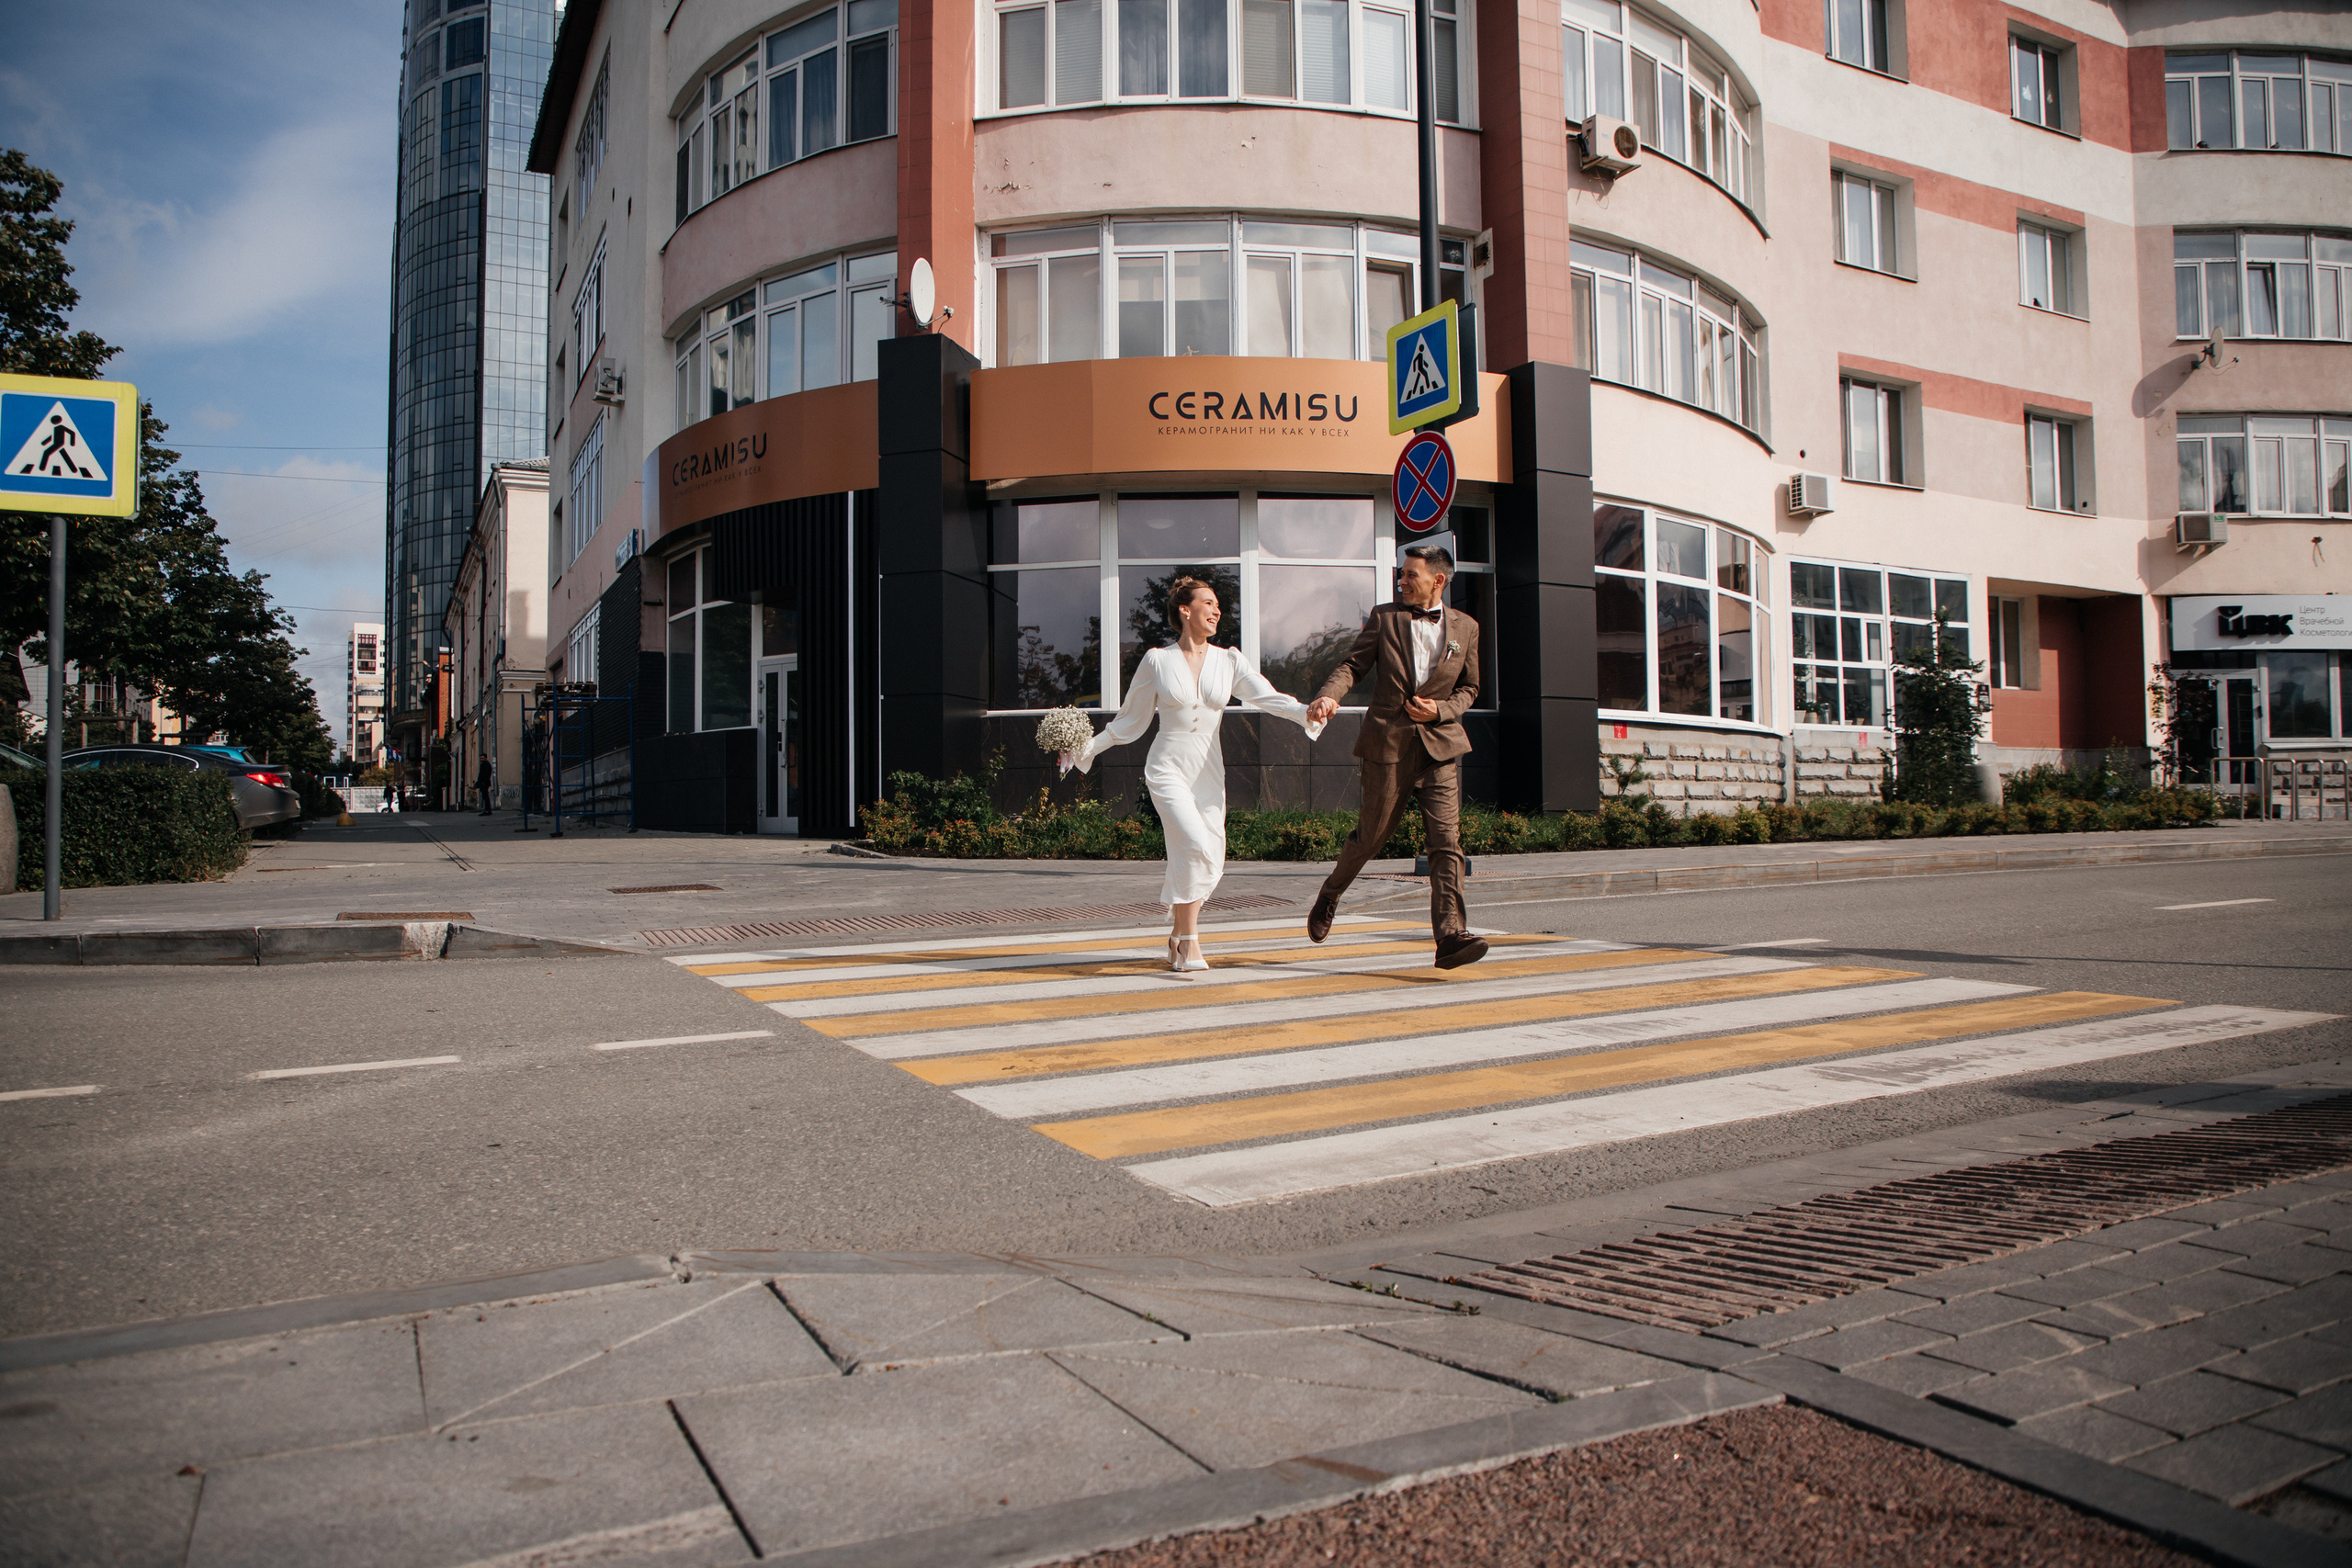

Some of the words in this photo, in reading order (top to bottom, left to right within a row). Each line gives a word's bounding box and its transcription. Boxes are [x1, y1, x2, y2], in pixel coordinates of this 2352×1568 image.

[1148, 391, 1358, 423] CERAMISU
[1158, 426, 1253, 435] КЕРАМОГРАНИТ
[1260, 426, 1276, 435] НИ
[1282, 427, 1304, 436] КАК
[1309, 428, 1317, 436] У
[1321, 428, 1350, 437] ВСЕХ
[673, 432, 767, 487] CERAMISU
[2299, 605, 2325, 615] Центр
[2300, 616, 2345, 626] Врачебной
